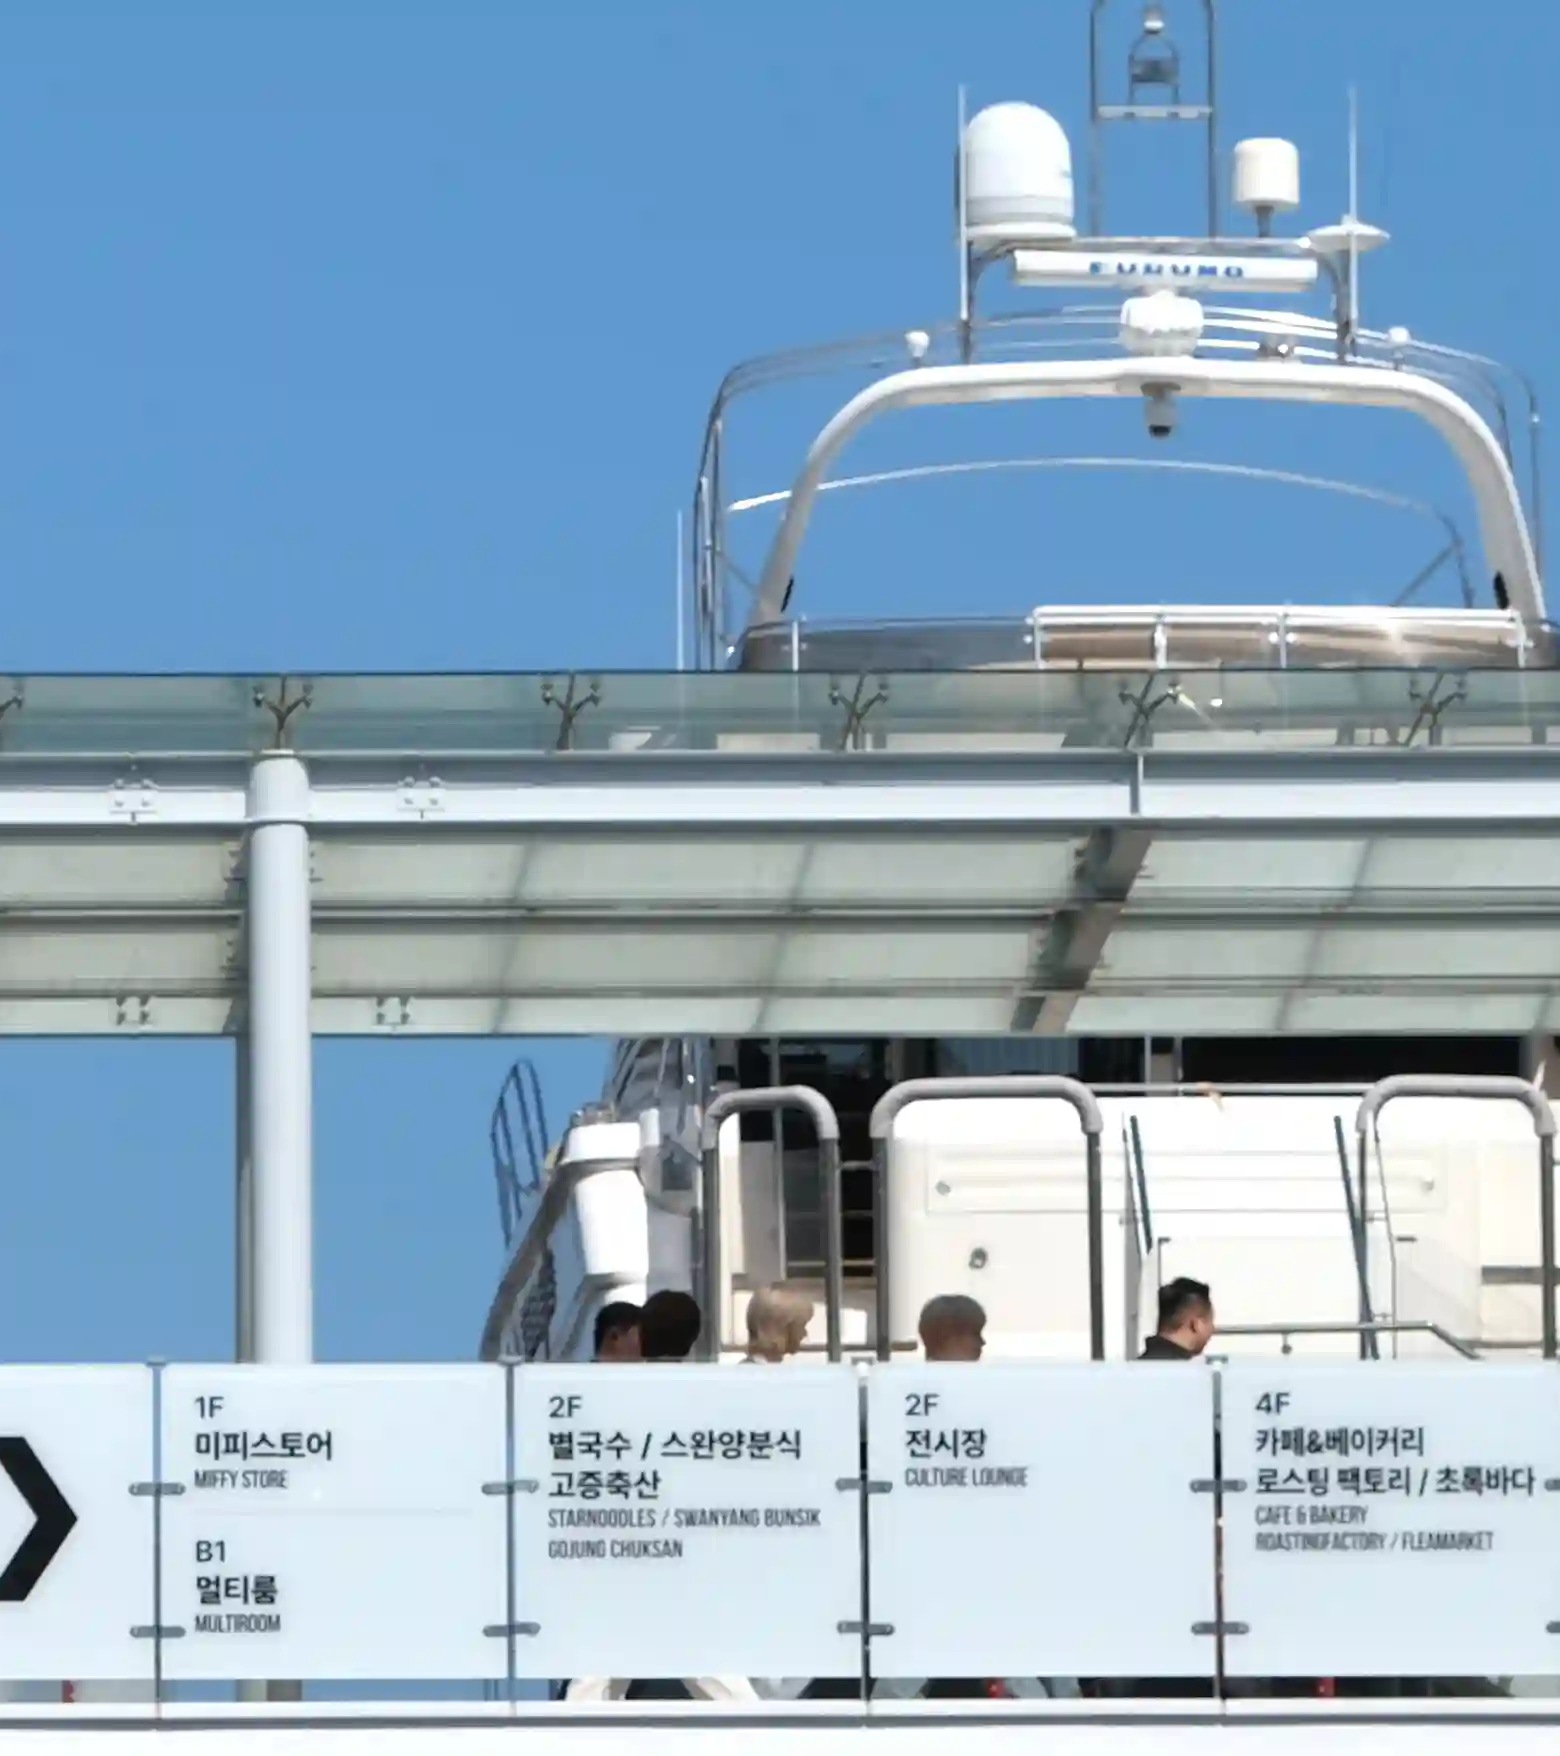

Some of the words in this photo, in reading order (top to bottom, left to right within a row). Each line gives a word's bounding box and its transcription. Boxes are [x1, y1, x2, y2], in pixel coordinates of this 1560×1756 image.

[1088, 261, 1245, 278] FURUNO
[195, 1396, 224, 1419] 1F
[549, 1396, 581, 1418] 2F
[905, 1393, 939, 1416] 2F
[1255, 1392, 1289, 1415] 4F
[196, 1431, 332, 1461] 미피스토어
[549, 1432, 632, 1460] 별국수
[661, 1430, 800, 1460] 스완양분식
[906, 1429, 987, 1459] 전시장
[1256, 1427, 1423, 1457] 카페&베이커리
[194, 1470, 238, 1488] MIFFY
[242, 1469, 287, 1489] STORE
[549, 1470, 661, 1500] 고증축산
[905, 1467, 968, 1487] CULTURE
[972, 1467, 1027, 1487] LOUNGE
[1256, 1467, 1329, 1497] 로스팅
[1337, 1467, 1410, 1496] 팩토리
[1436, 1466, 1535, 1496] 초록바다
[549, 1508, 656, 1528] STARNOODLES
[674, 1508, 760, 1528] SWANYANG
[764, 1508, 820, 1527] BUNSIK
[1255, 1505, 1292, 1526] CAFE
[1309, 1505, 1367, 1525] BAKERY
[196, 1540, 225, 1563] B1
[549, 1539, 606, 1559] GOJUNG
[610, 1539, 682, 1558] CHUKSAN
[1402, 1531, 1493, 1551] FLEAMARKET
[197, 1575, 278, 1605] 멀티룸
[195, 1614, 281, 1633] MULTIROOM
